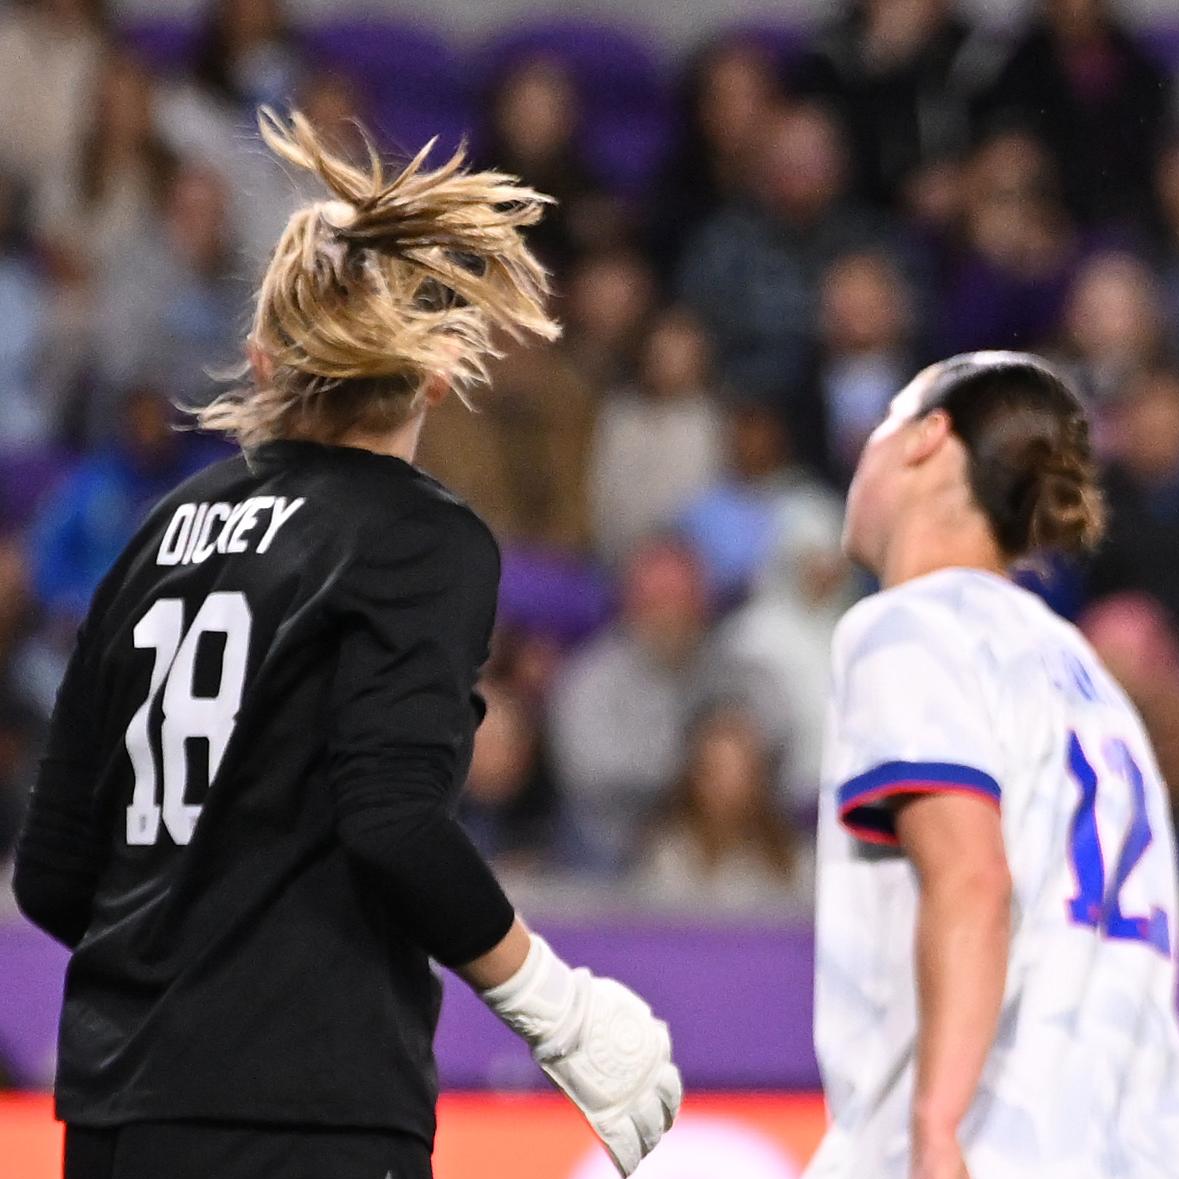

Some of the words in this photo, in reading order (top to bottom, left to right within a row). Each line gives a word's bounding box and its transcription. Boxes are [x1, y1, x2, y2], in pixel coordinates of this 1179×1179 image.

[156, 495, 306, 566] DICKEY
[126, 591, 252, 845] 18
[1065, 729, 1171, 957] 12
